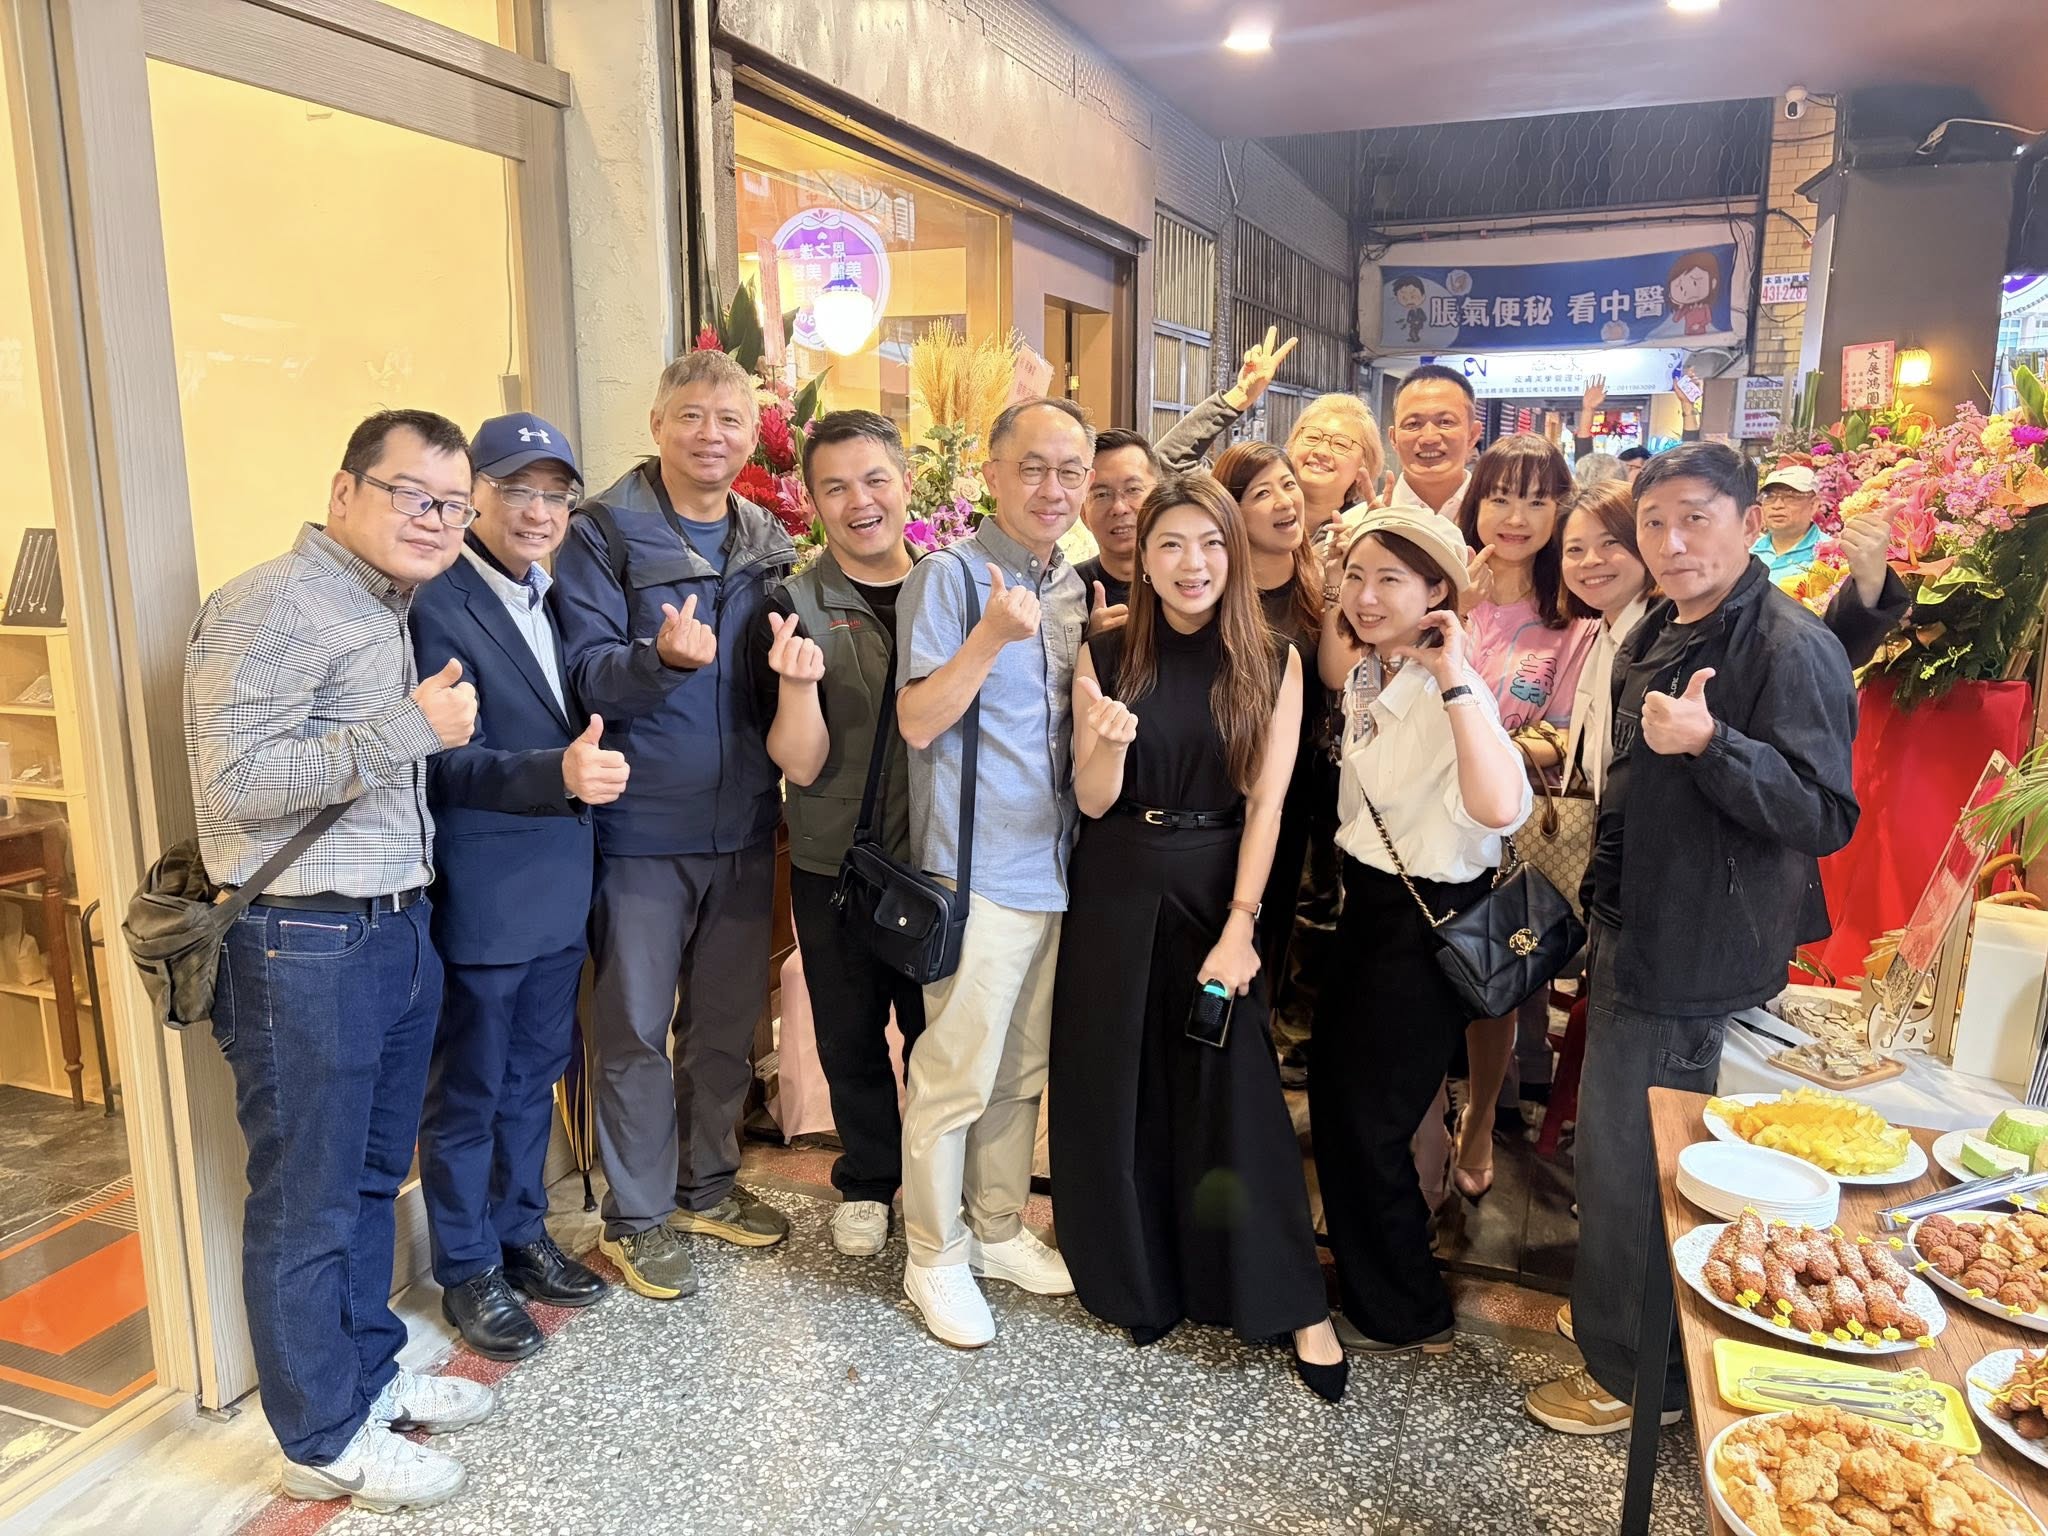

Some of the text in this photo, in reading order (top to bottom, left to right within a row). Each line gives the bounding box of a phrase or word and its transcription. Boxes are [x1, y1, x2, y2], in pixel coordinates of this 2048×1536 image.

[1430, 285, 1665, 328] 脹氣便秘 看中醫
[1867, 347, 1880, 405] 大展鴻圖
